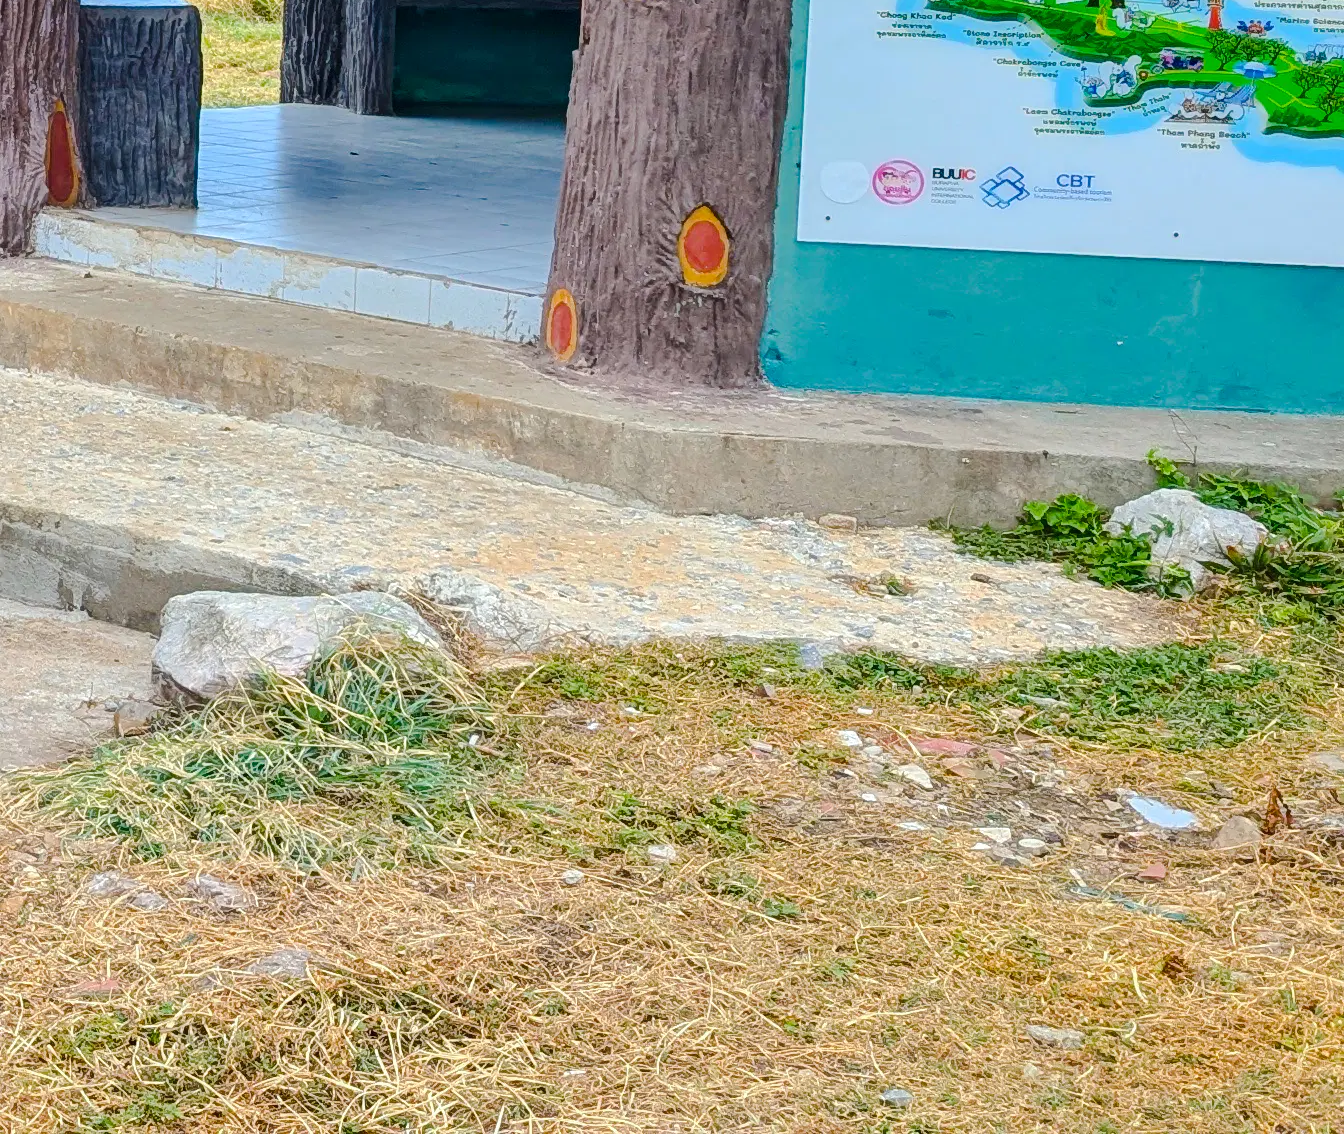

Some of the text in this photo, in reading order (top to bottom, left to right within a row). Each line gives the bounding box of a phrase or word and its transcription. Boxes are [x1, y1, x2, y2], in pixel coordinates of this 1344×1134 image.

[1187, 129, 1216, 139] Phang
[932, 167, 977, 181] BUUIC
[1056, 173, 1096, 189] CBT
